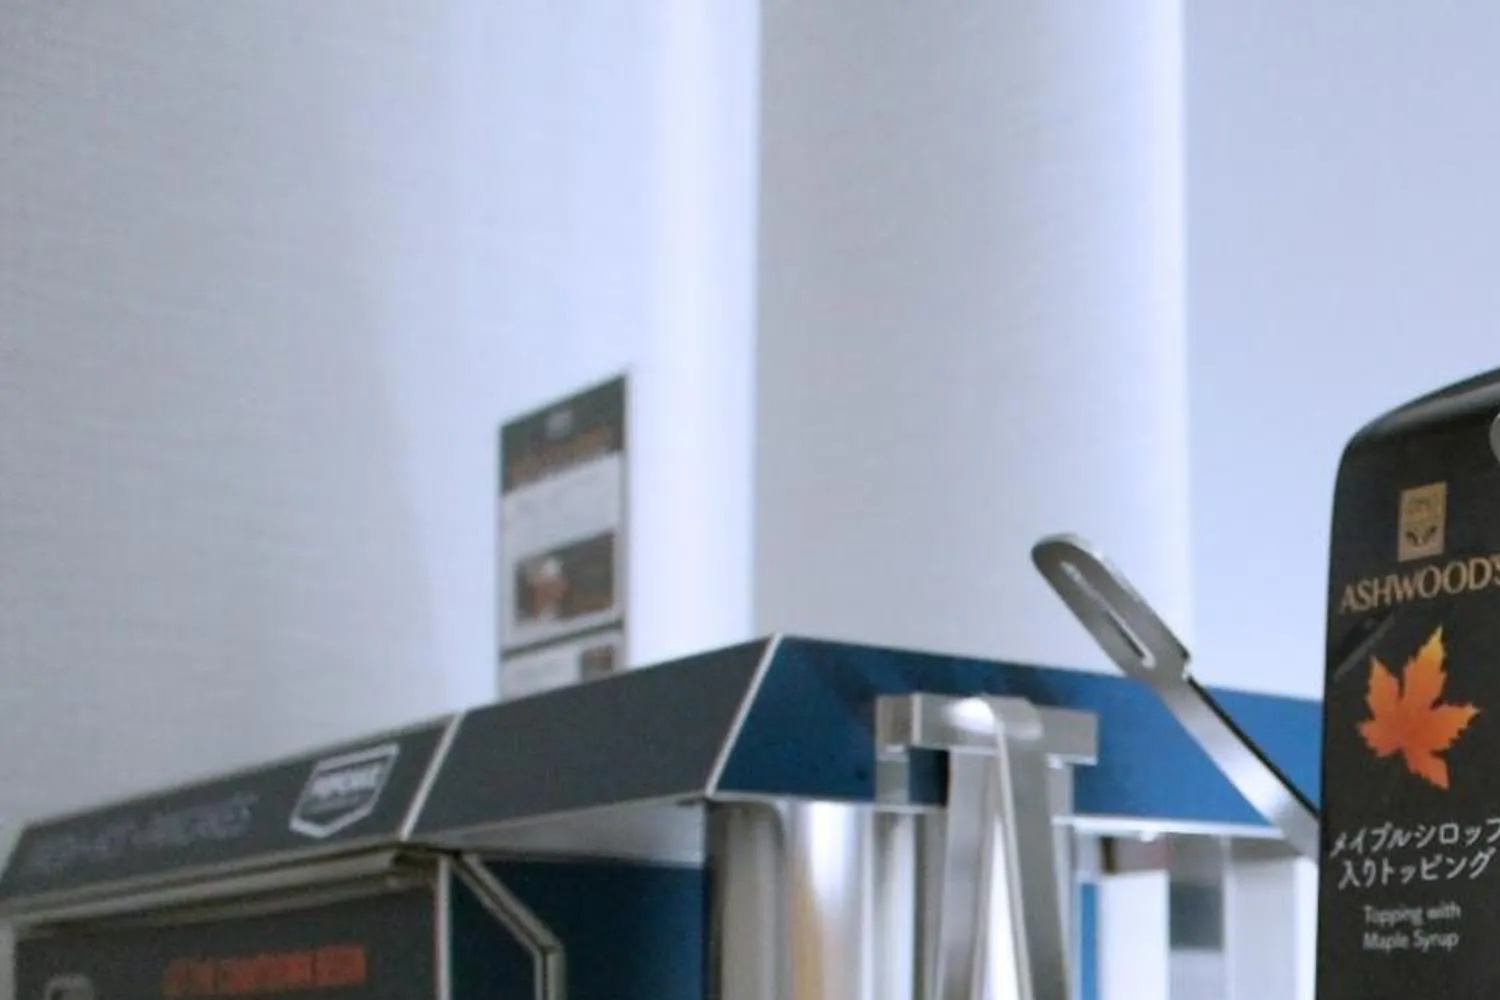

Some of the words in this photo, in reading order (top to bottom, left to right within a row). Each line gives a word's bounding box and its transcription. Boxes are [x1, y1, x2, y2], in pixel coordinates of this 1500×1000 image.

[1338, 846, 1497, 890] 入りトッピング
[1364, 904, 1424, 926] Topping
[1426, 901, 1462, 921] with
[1363, 932, 1409, 954] Maple
[1413, 929, 1459, 952] Syrup
